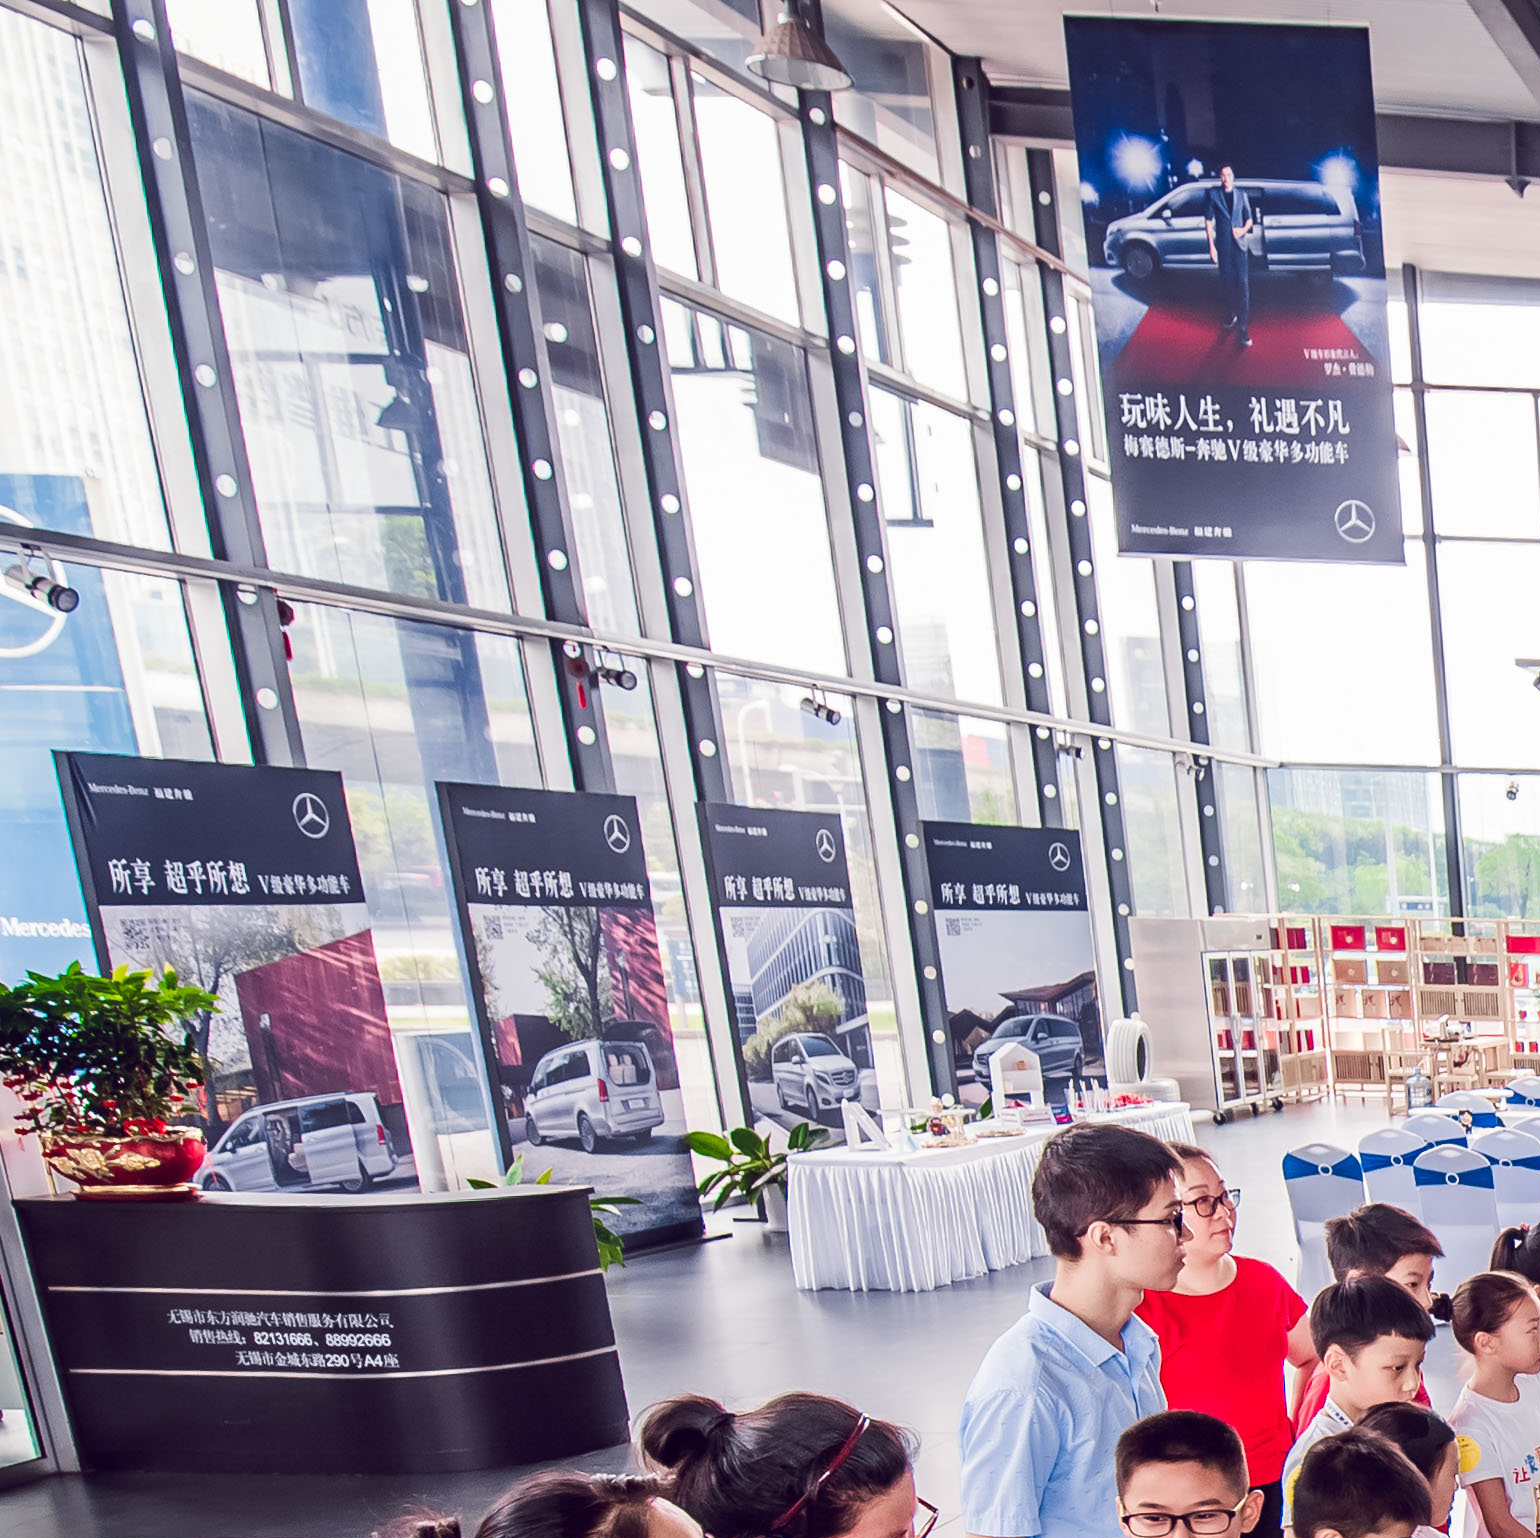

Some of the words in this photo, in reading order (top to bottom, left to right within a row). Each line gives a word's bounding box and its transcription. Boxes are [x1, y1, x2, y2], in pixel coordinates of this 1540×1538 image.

[1119, 392, 1351, 436] 玩味人生，礼遇不凡
[108, 857, 155, 896] 所享
[163, 858, 251, 896] 超乎所想
[474, 867, 508, 898] 所享
[513, 868, 574, 900] 超乎所想
